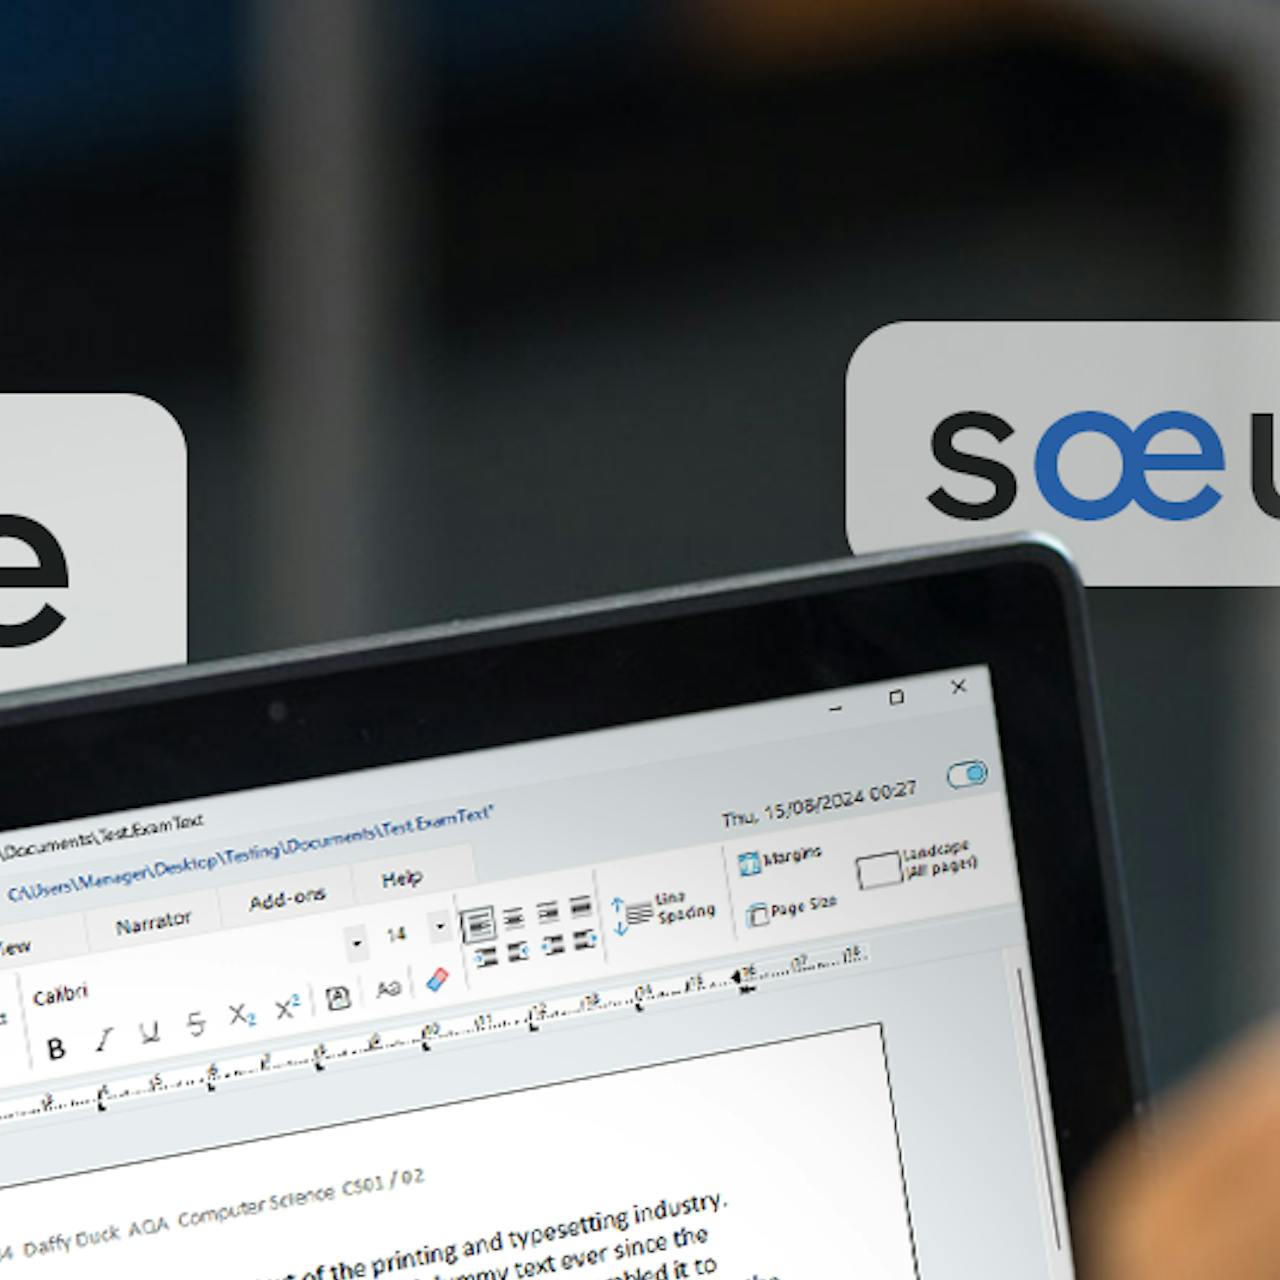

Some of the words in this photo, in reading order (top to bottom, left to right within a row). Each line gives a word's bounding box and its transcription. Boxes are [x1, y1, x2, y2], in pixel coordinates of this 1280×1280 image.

[721, 811, 761, 829] Thu,
[764, 789, 867, 820] 15/08/2024
[869, 779, 917, 803] 00:27
[762, 846, 823, 868] Margins
[381, 869, 424, 889] Help
[248, 887, 328, 913] Add-ons
[654, 892, 686, 907] Line
[771, 901, 806, 918] Page
[809, 895, 838, 911] Size
[115, 911, 193, 937] Narrator
[656, 904, 717, 926] Spacing
[387, 925, 408, 943] 14
[32, 985, 89, 1007] Calibri
[23, 1233, 72, 1259] Daffy
[75, 1224, 121, 1249] Duck
[128, 1216, 170, 1238] AQA
[177, 1199, 267, 1228] Computer
[269, 1186, 336, 1211] Science
[401, 1167, 426, 1186] 02
[371, 1244, 459, 1280] printing
[464, 1231, 504, 1257] and
[508, 1211, 630, 1250] typesetting
[633, 1193, 728, 1224] industry.
[514, 1255, 557, 1280] text
[561, 1247, 608, 1271] ever
[613, 1235, 668, 1260] since
[673, 1227, 708, 1249] the
[673, 1260, 690, 1280] it
[694, 1257, 718, 1276] to
